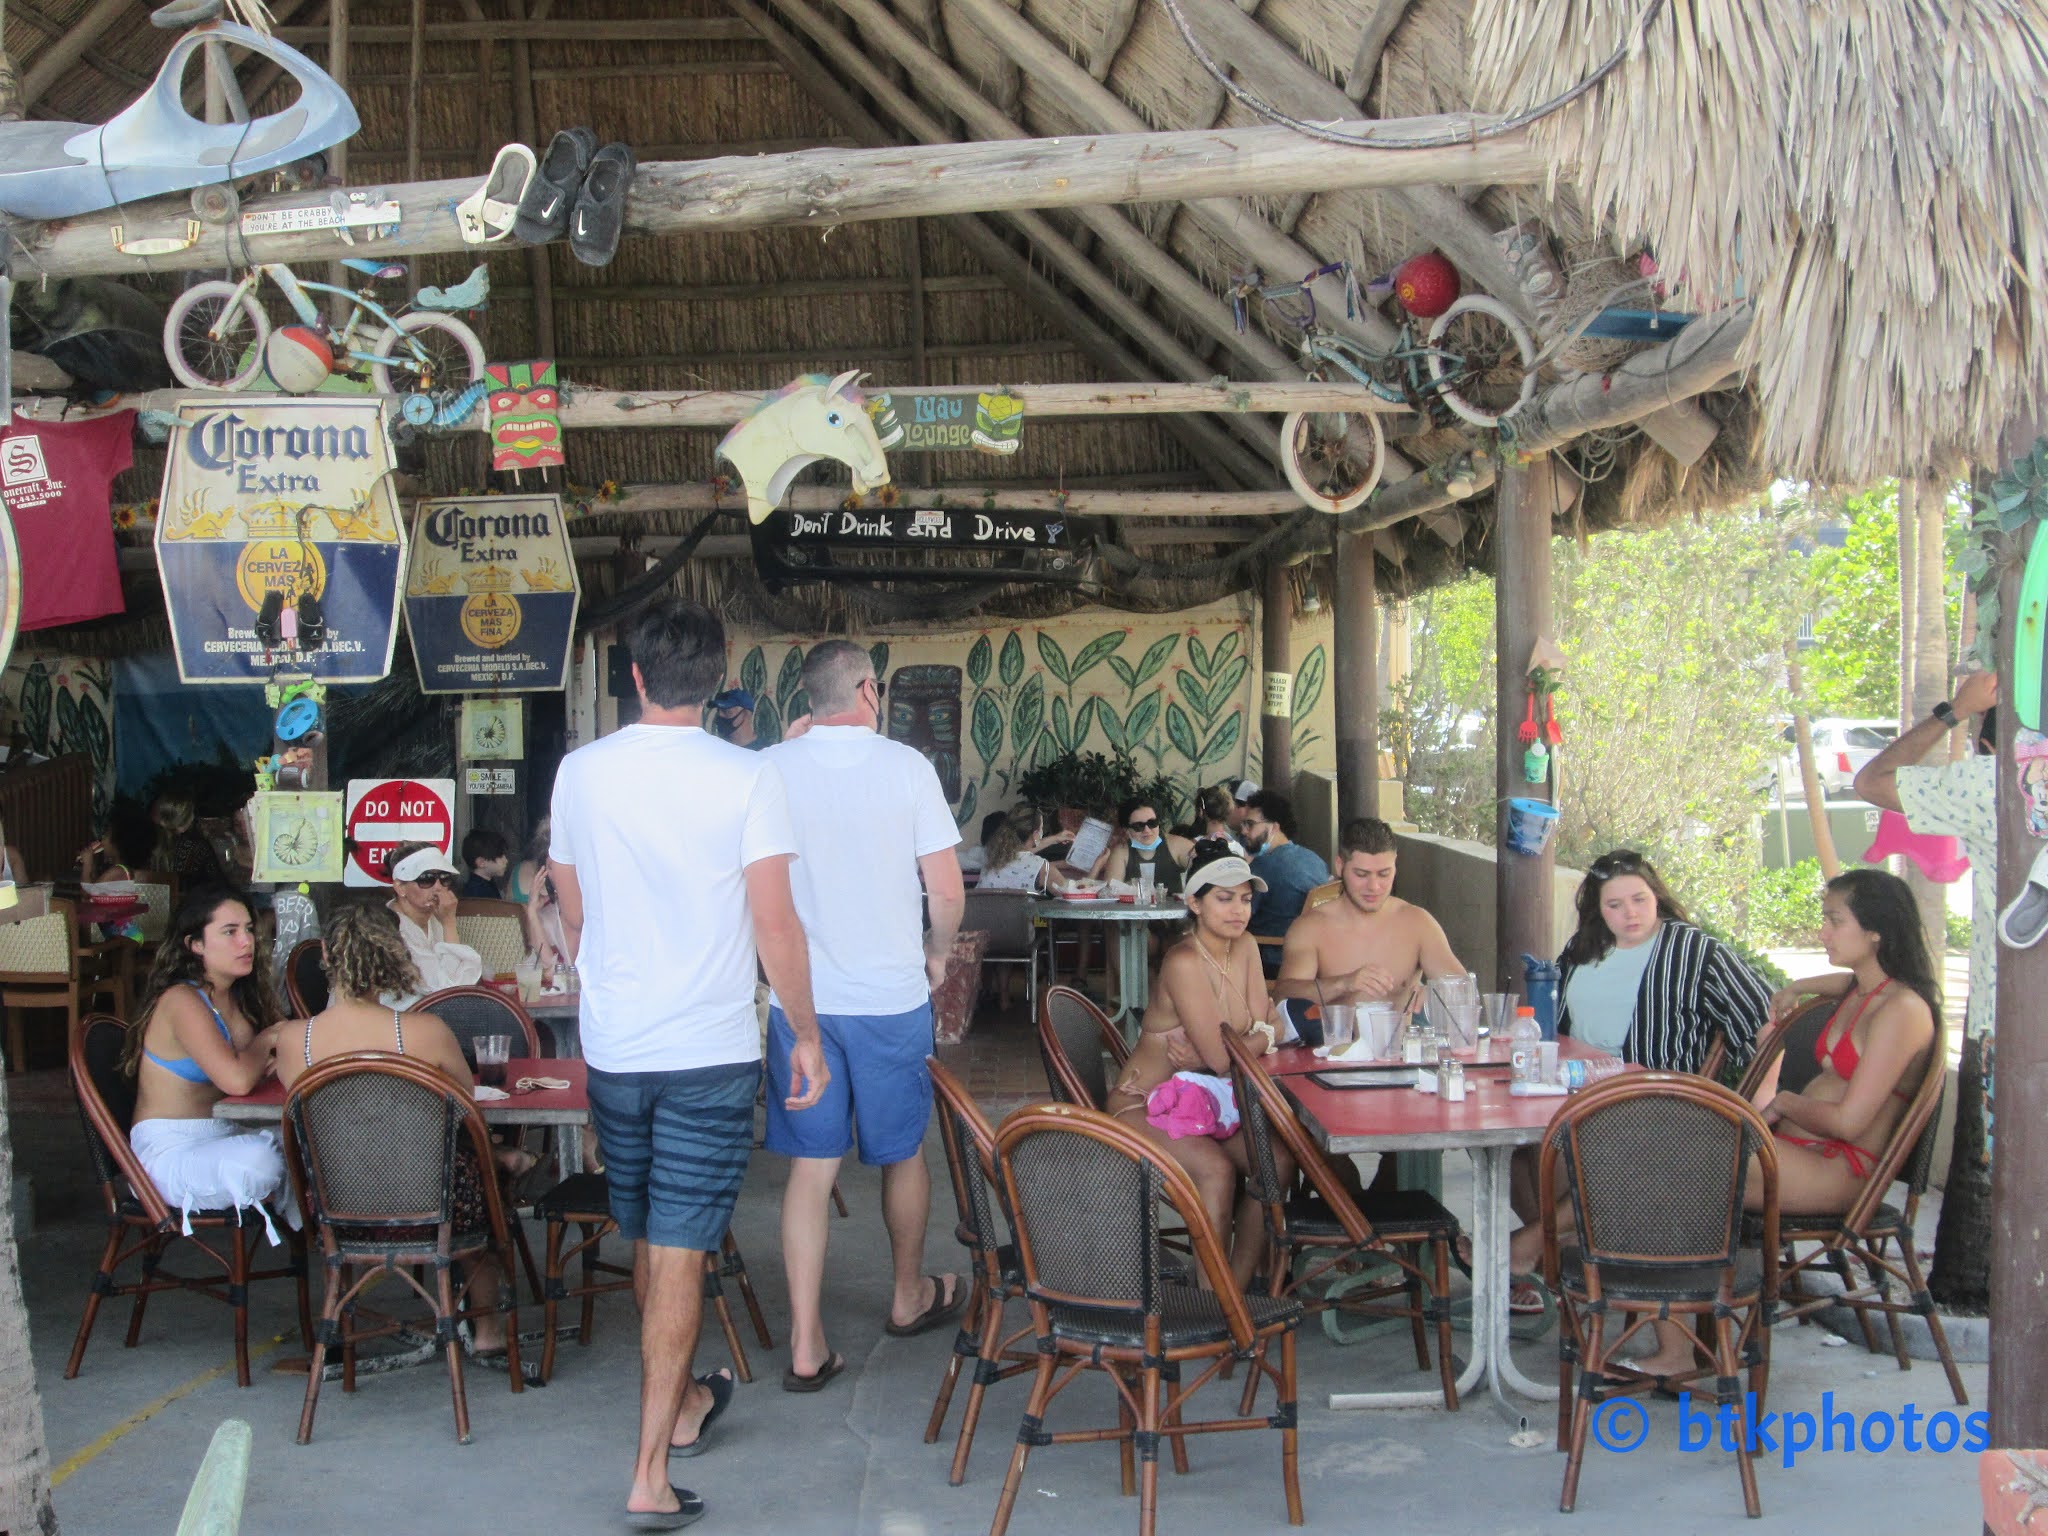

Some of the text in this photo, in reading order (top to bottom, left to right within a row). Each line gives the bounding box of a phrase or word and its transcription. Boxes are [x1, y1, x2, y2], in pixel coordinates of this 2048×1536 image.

[252, 208, 332, 222] DON'T BE CRABBY
[250, 221, 278, 232] YOU'RE
[282, 221, 293, 230] AT
[299, 219, 313, 228] THE
[914, 396, 963, 422] Luau
[903, 423, 971, 448] Lounge
[187, 411, 373, 475] Corona
[237, 463, 320, 494] Extra
[425, 506, 552, 550] Corona
[839, 512, 893, 536] Drink
[906, 516, 952, 539] and
[974, 514, 1036, 542] Drive
[270, 547, 289, 560] LA
[461, 543, 518, 562] Extra
[484, 599, 498, 608] LA
[468, 608, 514, 617] CERVEZA
[480, 618, 502, 627] MAS
[326, 629, 339, 640] by
[480, 627, 503, 637] FINA
[204, 641, 264, 652] CERVECERIA
[454, 652, 531, 663] Brewed and bottled by
[437, 663, 481, 673] CERVECERIA
[481, 663, 511, 672] MODELO
[365, 801, 436, 817] DO NOT
